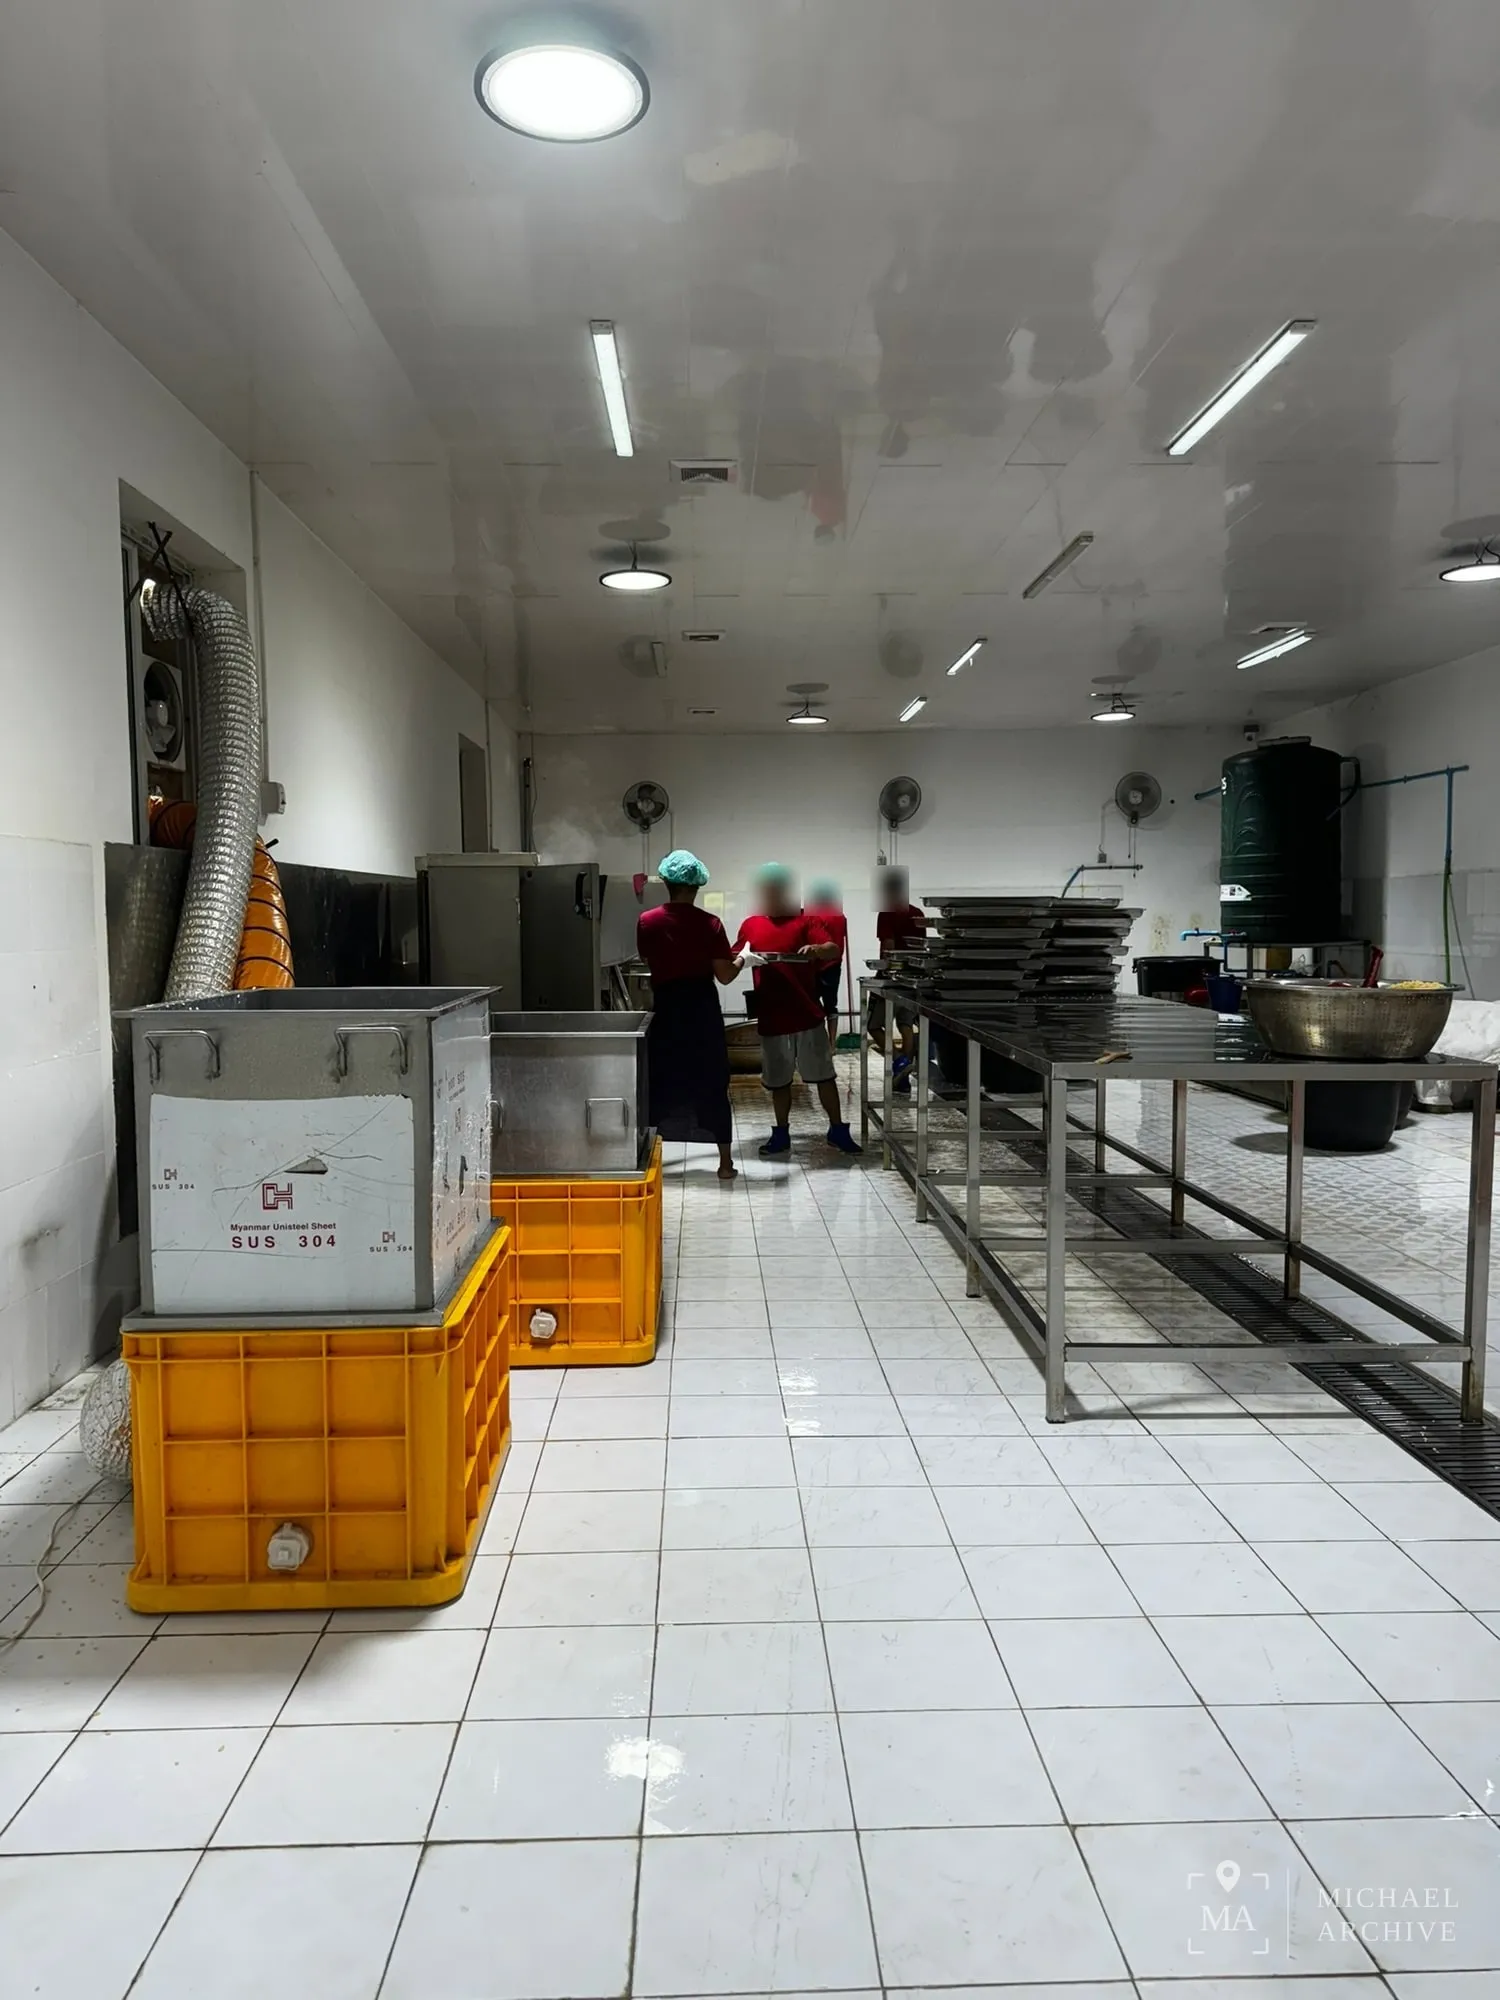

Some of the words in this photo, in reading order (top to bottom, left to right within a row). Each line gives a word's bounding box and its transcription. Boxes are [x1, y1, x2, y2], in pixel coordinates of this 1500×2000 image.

[230, 1223, 270, 1232] Myanmar
[311, 1222, 337, 1230] Sheet
[232, 1236, 276, 1248] SUS
[298, 1235, 336, 1247] 304
